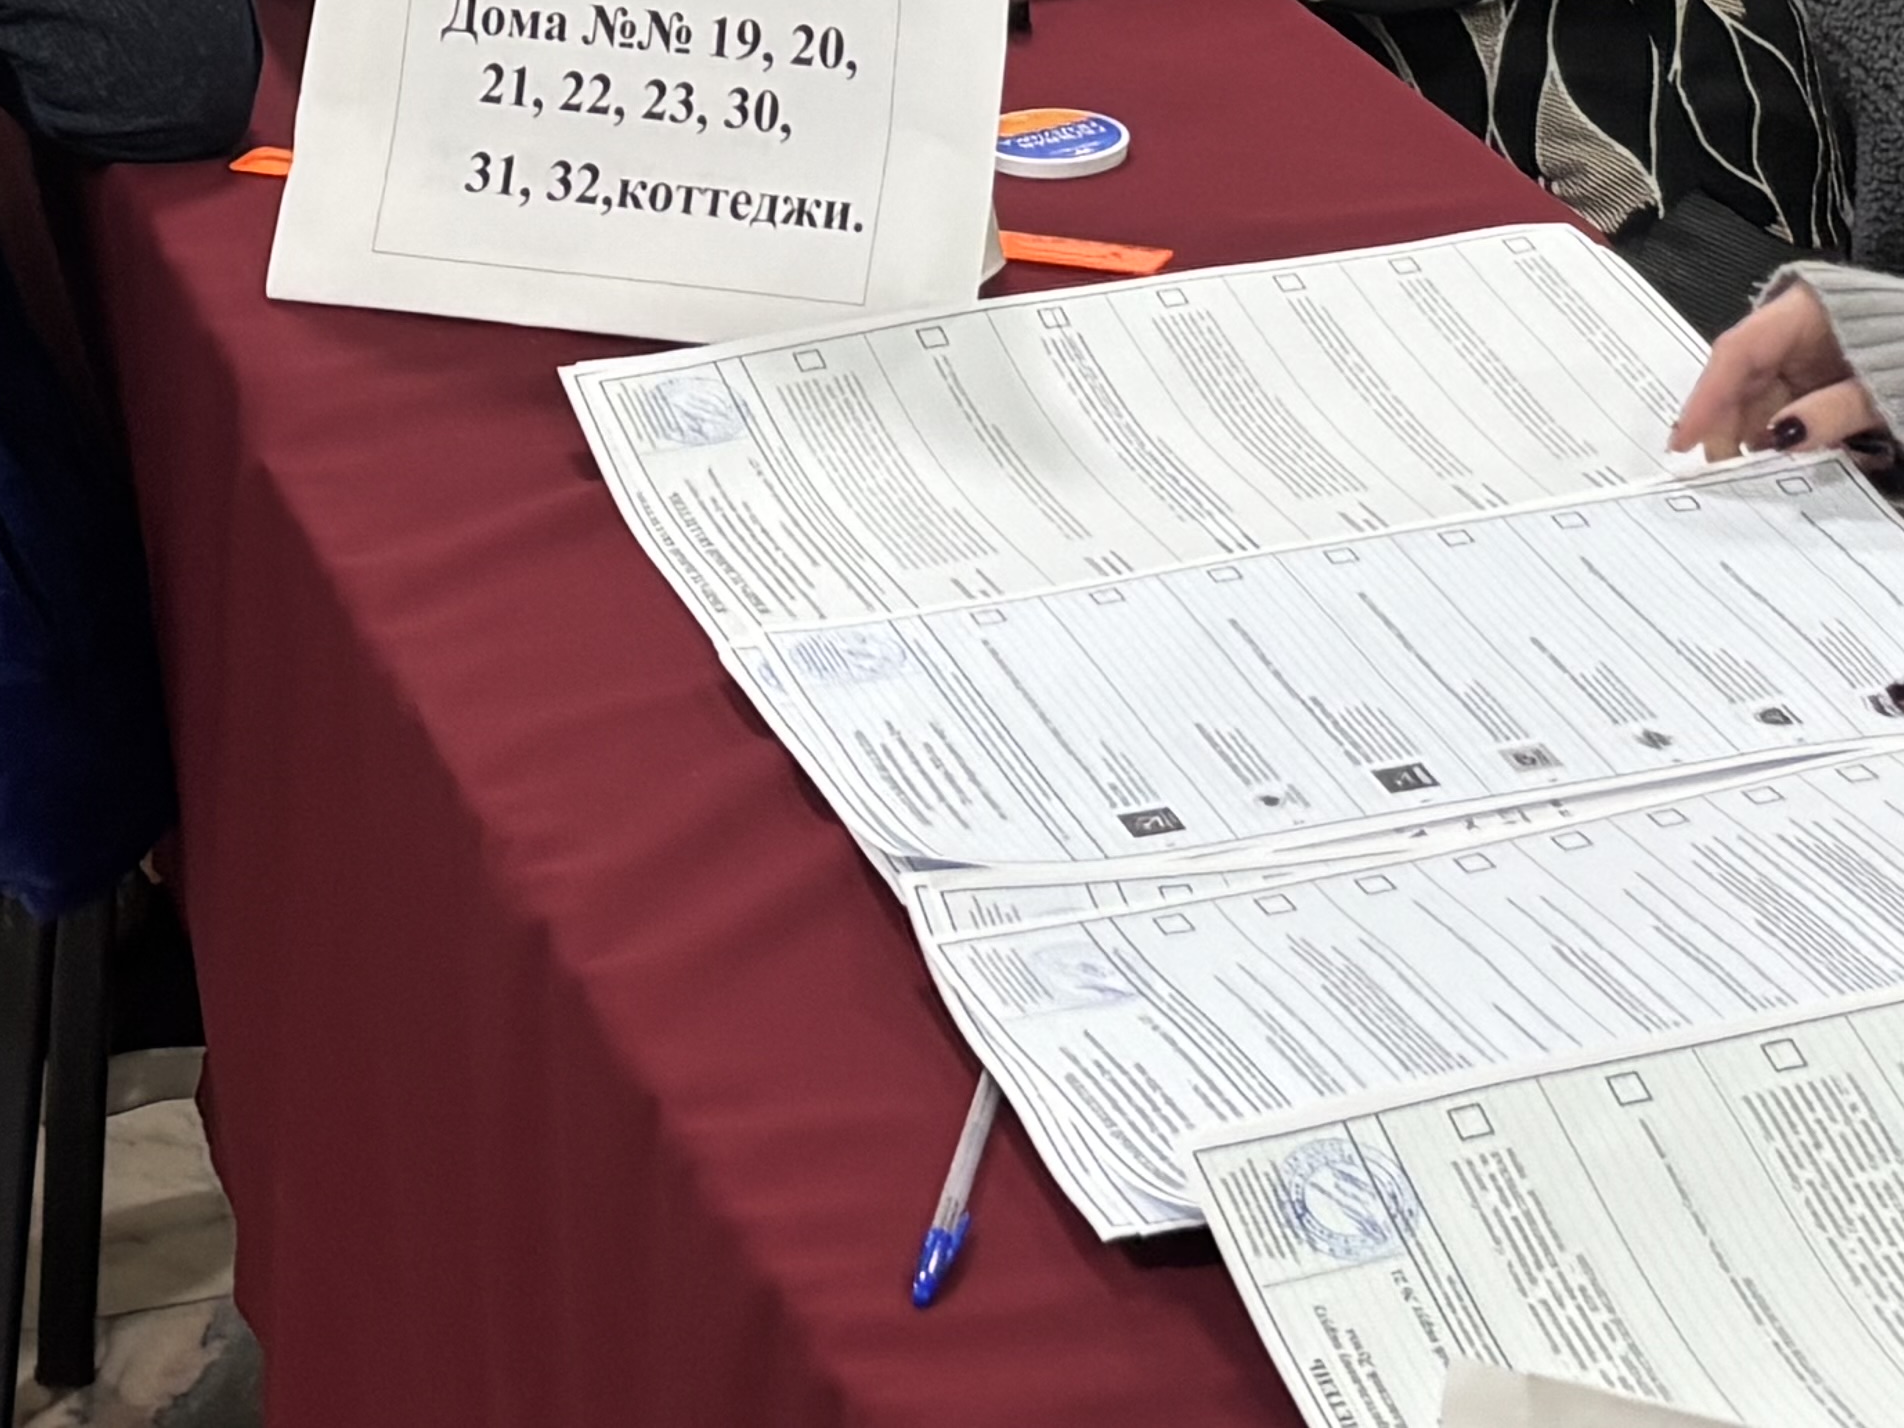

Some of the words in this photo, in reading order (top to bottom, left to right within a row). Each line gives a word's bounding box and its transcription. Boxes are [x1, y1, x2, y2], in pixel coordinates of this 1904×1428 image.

[581, 4, 693, 55] №№
[711, 17, 774, 73] 19,
[790, 24, 858, 79] 20,
[480, 62, 544, 117] 21,
[559, 70, 626, 125] 22,
[641, 78, 708, 133] 23,
[723, 86, 792, 142] 30,
[464, 151, 532, 206] 31,
[545, 160, 864, 234] 32,коттеджи.
